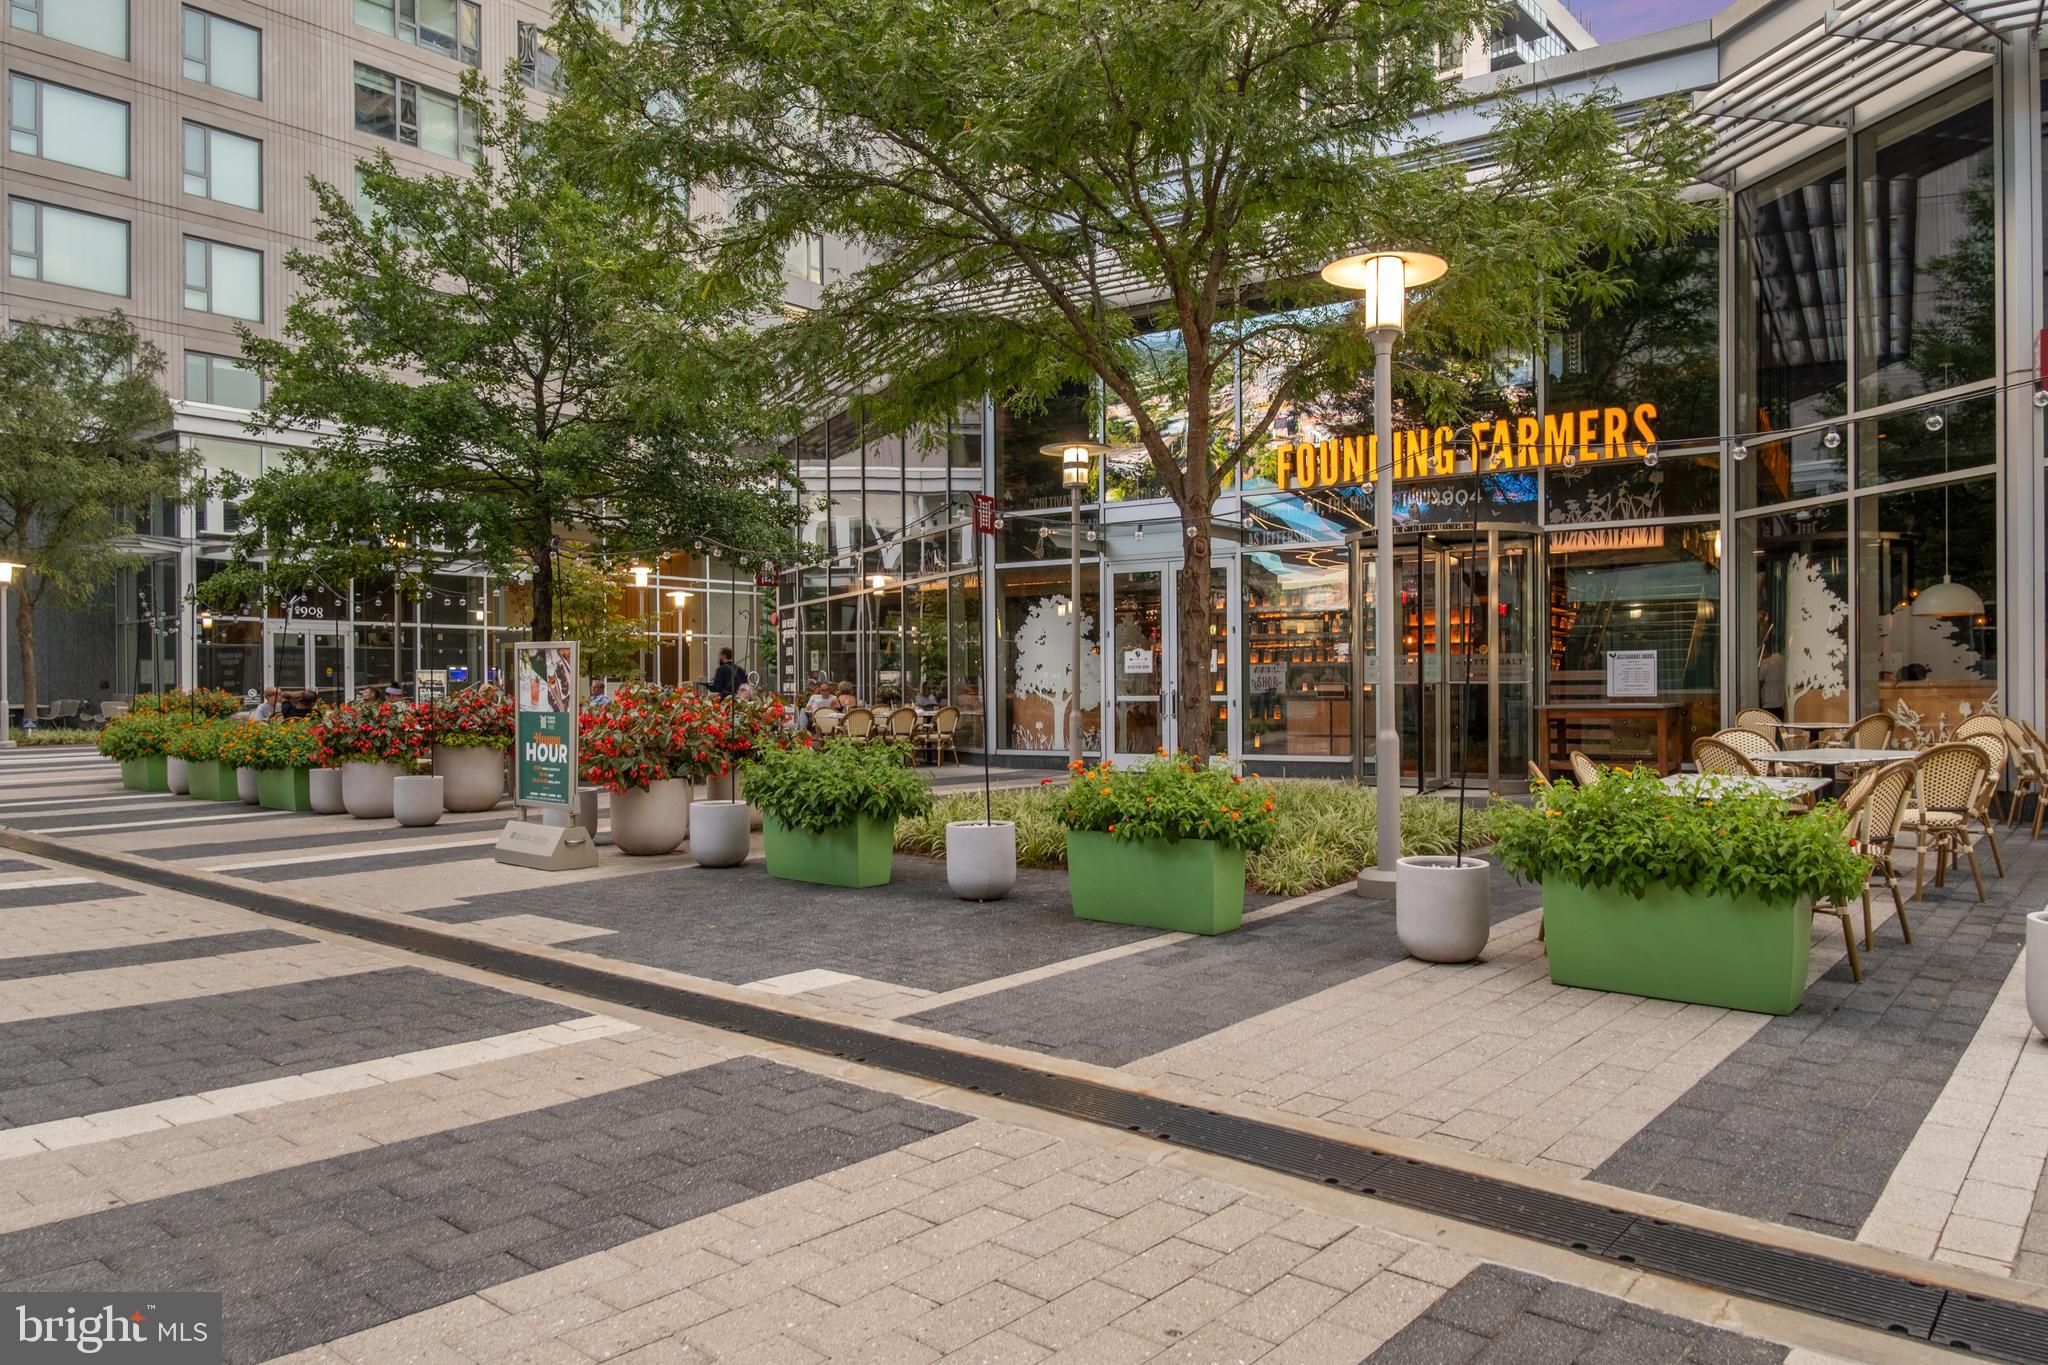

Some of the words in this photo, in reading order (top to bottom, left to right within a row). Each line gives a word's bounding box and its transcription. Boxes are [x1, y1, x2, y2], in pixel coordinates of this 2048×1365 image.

[1472, 403, 1658, 472] FARMERS
[1350, 494, 1375, 512] MOS
[525, 741, 568, 764] HOUR
